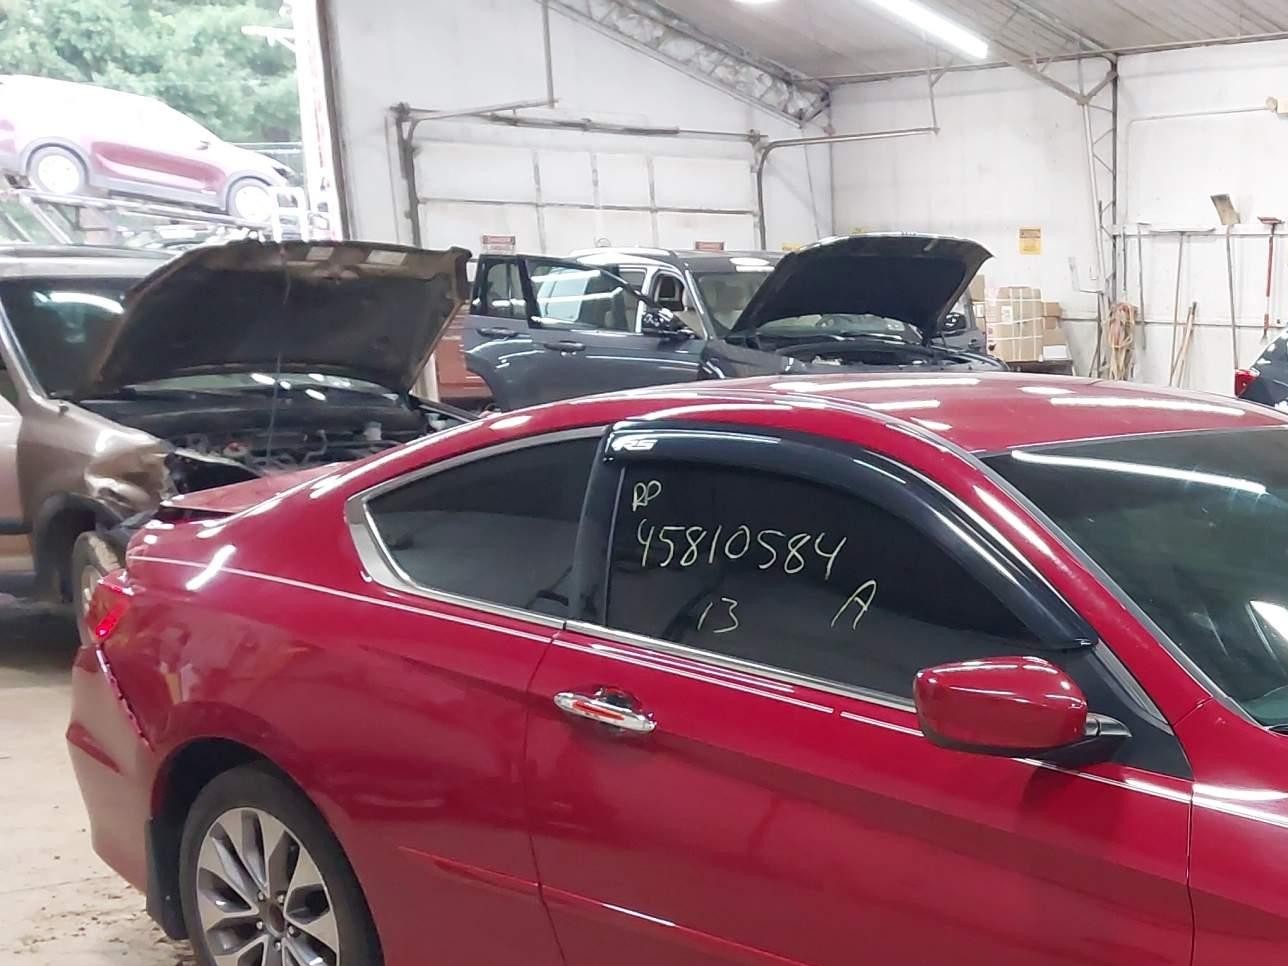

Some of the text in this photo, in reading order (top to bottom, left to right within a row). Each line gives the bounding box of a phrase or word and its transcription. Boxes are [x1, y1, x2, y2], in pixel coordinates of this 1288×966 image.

[636, 518, 847, 580] 45810584
[697, 580, 877, 633] 13 A
